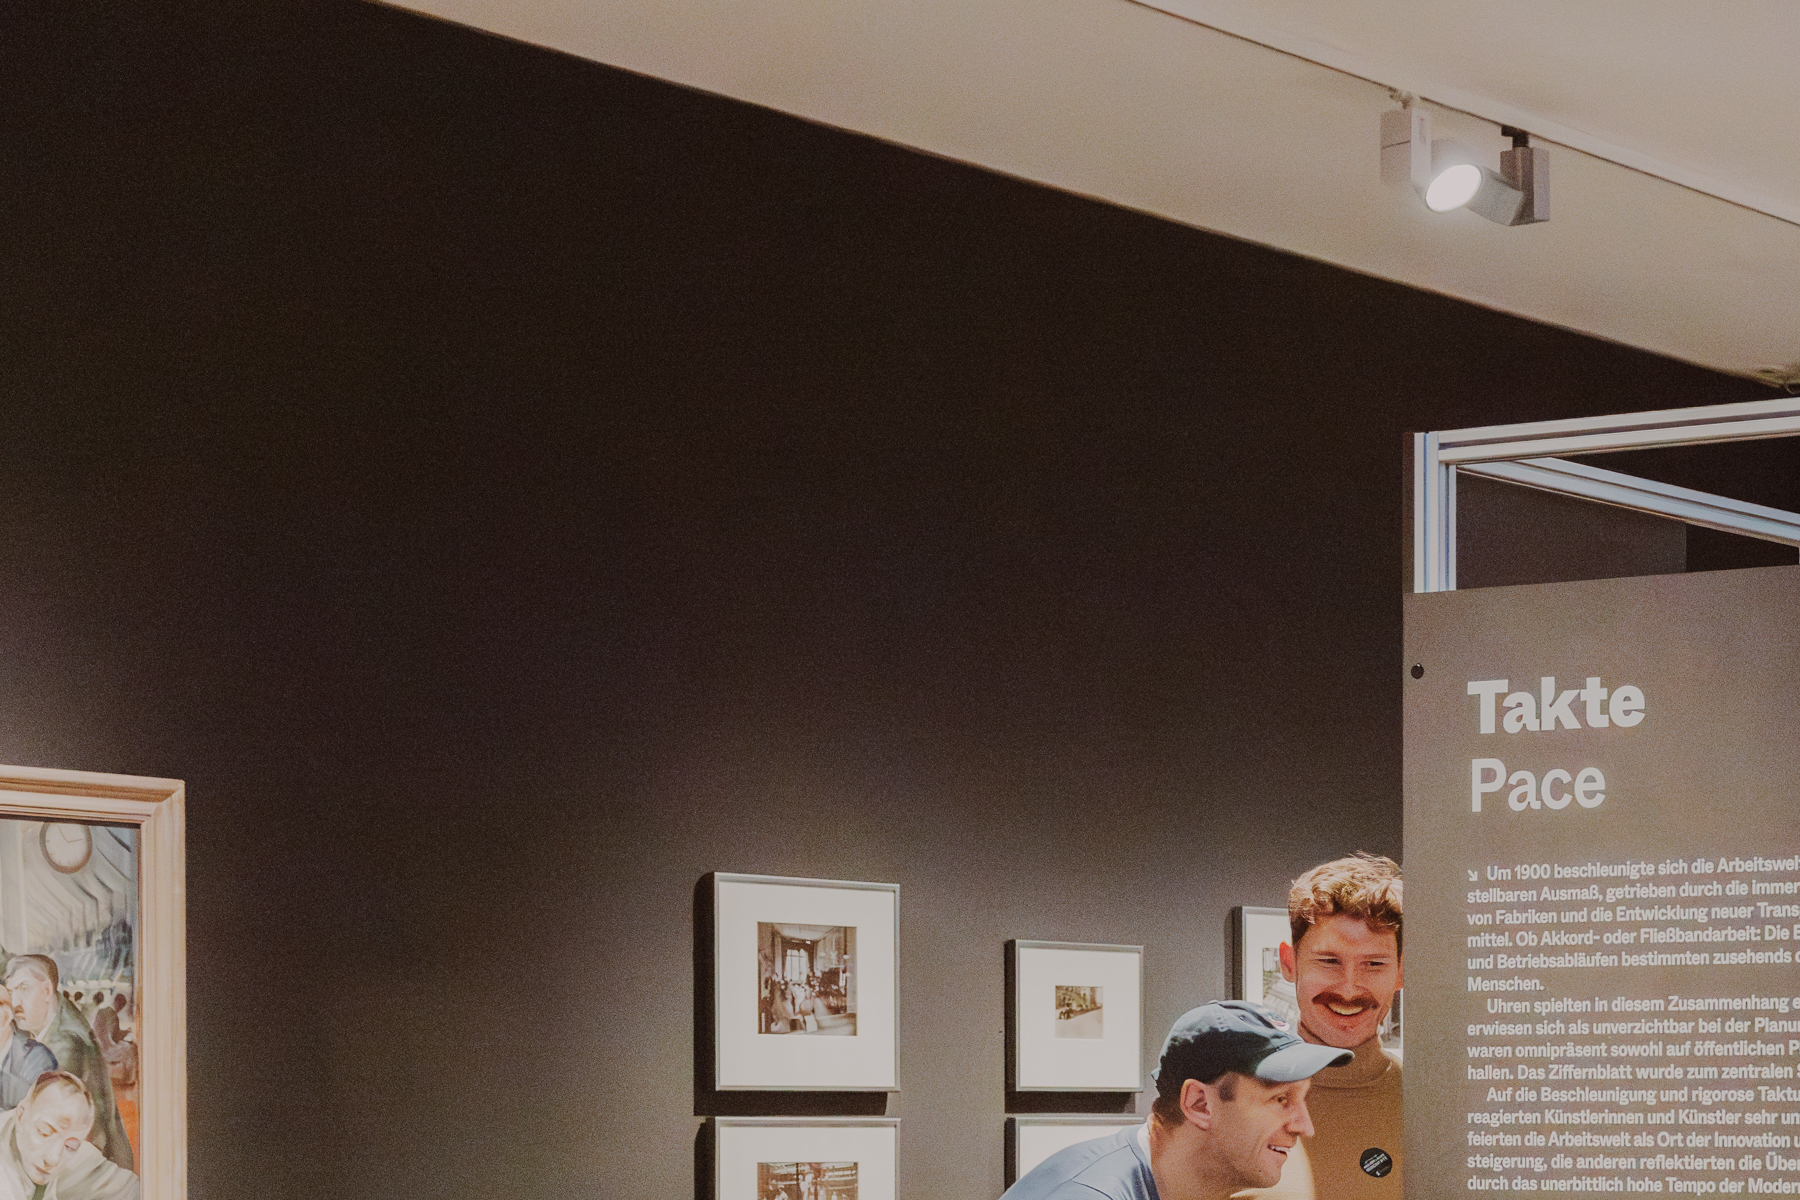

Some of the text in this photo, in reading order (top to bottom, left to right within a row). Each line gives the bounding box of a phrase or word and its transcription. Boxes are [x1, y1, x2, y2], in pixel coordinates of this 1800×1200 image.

[1466, 675, 1646, 735] Takte
[1470, 757, 1607, 812] Pace
[1487, 865, 1511, 880] Um
[1515, 863, 1551, 879] 1900
[1554, 861, 1655, 879] beschleunigte
[1658, 859, 1688, 875] sich
[1691, 858, 1714, 874] die
[1467, 888, 1537, 903] stellbaren
[1540, 884, 1603, 901] Ausmaß,
[1606, 883, 1675, 902] getrieben
[1680, 881, 1722, 897] durch
[1726, 880, 1748, 896] die
[1752, 880, 1800, 894] immer
[1467, 913, 1492, 925] von
[1496, 909, 1557, 924] Fabriken
[1561, 907, 1587, 923] und
[1591, 906, 1612, 922] die
[1617, 904, 1708, 922] Entwicklung
[1712, 907, 1754, 919] neuer
[1467, 932, 1512, 947] mittel.
[1516, 932, 1537, 946] Ob
[1541, 930, 1600, 945] Akkord-
[1603, 929, 1637, 944] oder
[1641, 925, 1760, 943] Fließbandarbeit:
[1765, 925, 1789, 940] Die
[1468, 955, 1493, 969] und
[1498, 952, 1618, 968] Betriebsabläufen
[1622, 951, 1709, 966] bestimmten
[1713, 948, 1792, 964] zusehends
[1468, 976, 1544, 992] Menschen.
[1487, 999, 1530, 1014] Uhren
[1534, 998, 1591, 1016] spielten
[1595, 997, 1608, 1011] in
[1611, 997, 1664, 1011] diesem
[1668, 994, 1789, 1013] Zusammenhang
[1467, 1175, 1509, 1190] durch
[1512, 1176, 1538, 1191] das
[1541, 1176, 1623, 1192] unerbittlich
[1627, 1177, 1663, 1192] hohe
[1665, 1177, 1716, 1196] Tempo
[1719, 1178, 1745, 1193] der
